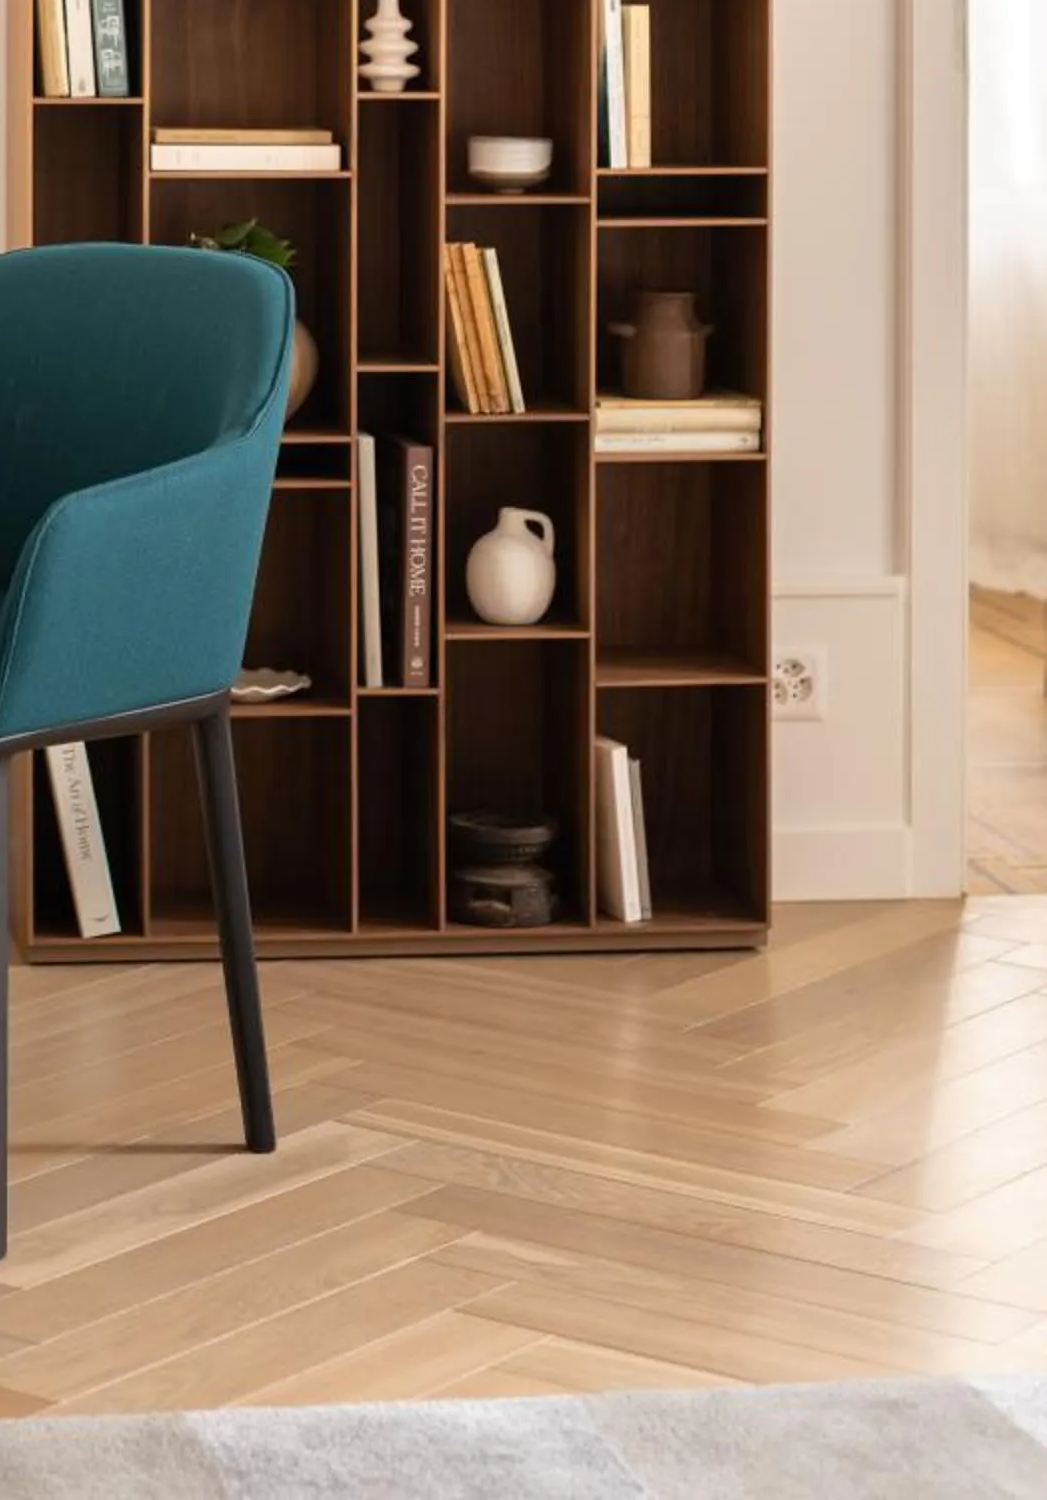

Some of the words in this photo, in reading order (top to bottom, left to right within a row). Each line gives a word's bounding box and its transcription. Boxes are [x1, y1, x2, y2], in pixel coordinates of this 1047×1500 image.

[409, 464, 428, 513] CALL
[409, 516, 427, 535] IT
[408, 538, 427, 597] HOME
[61, 746, 77, 774] The
[67, 777, 84, 799] Art
[75, 815, 93, 862] Home
